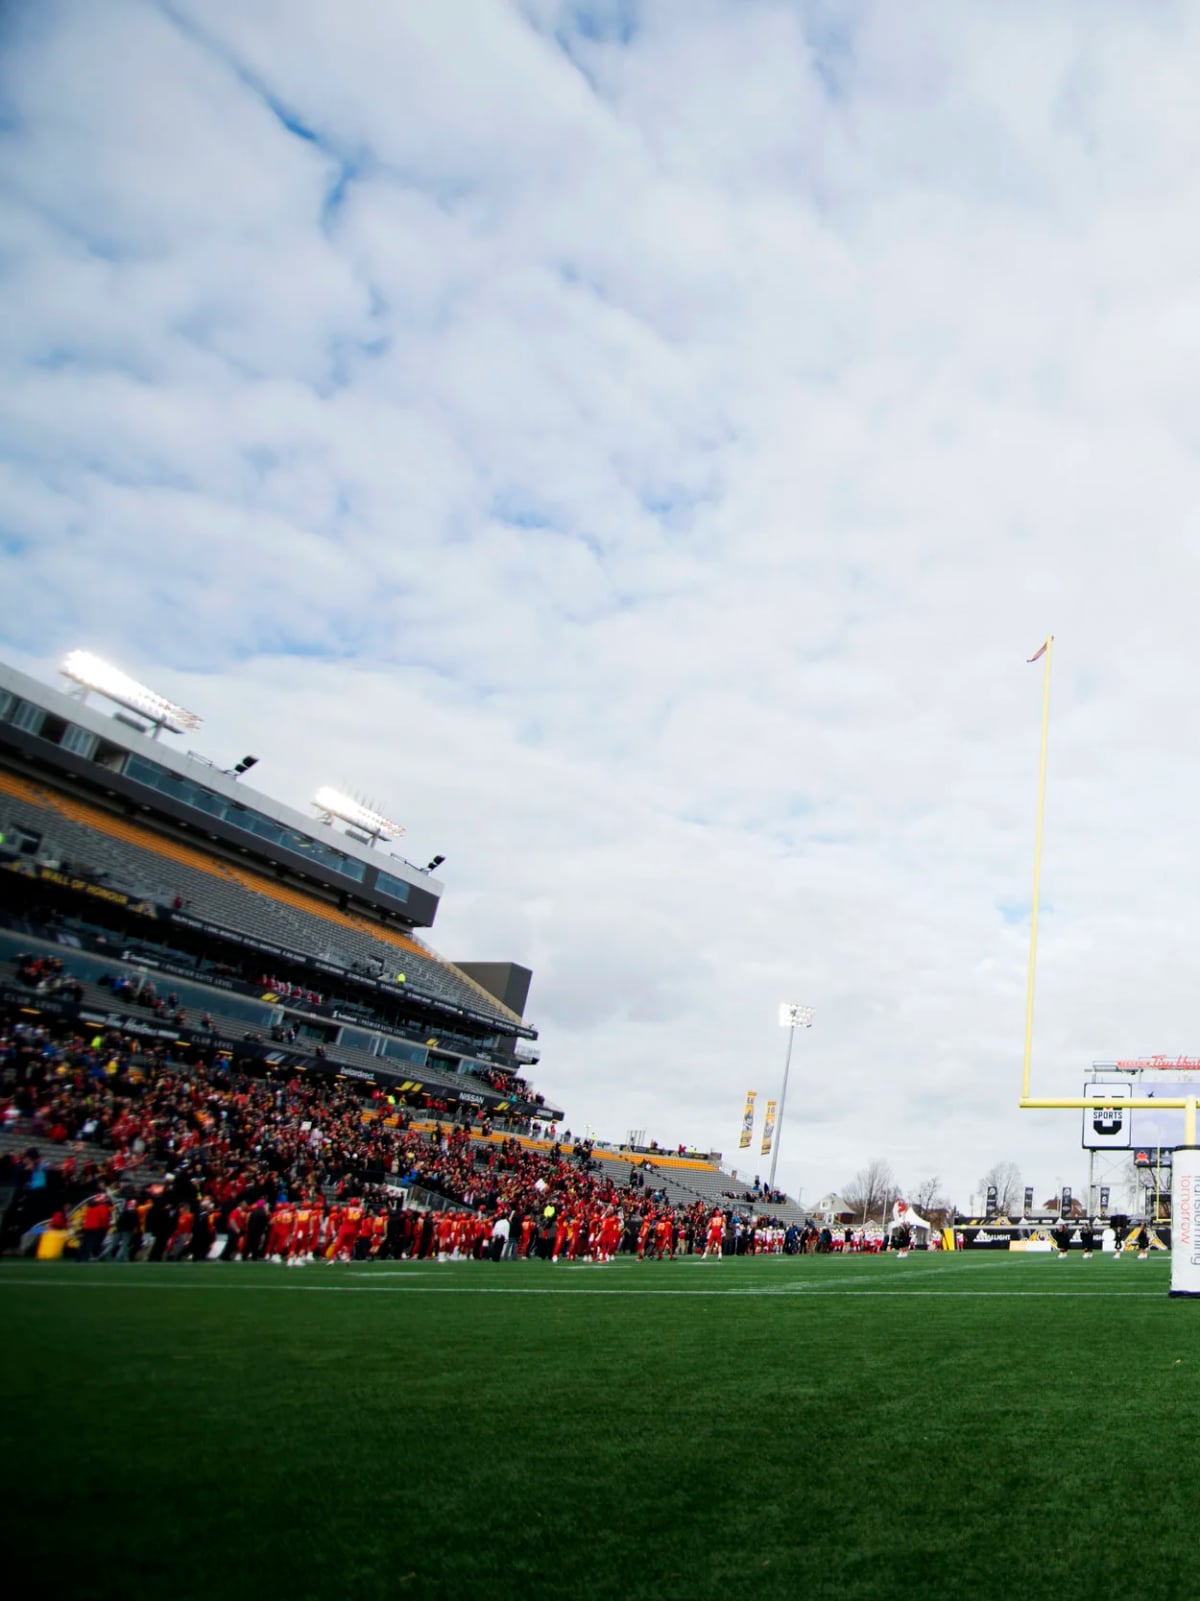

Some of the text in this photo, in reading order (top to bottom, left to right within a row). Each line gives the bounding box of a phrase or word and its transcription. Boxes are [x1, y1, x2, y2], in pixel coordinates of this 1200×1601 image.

[191, 1034, 211, 1046] CLUB
[214, 1039, 234, 1050] LEVEL
[459, 1092, 484, 1104] NISSAN
[1093, 1111, 1123, 1119] SPORTS
[1180, 1175, 1192, 1245] tomorrow
